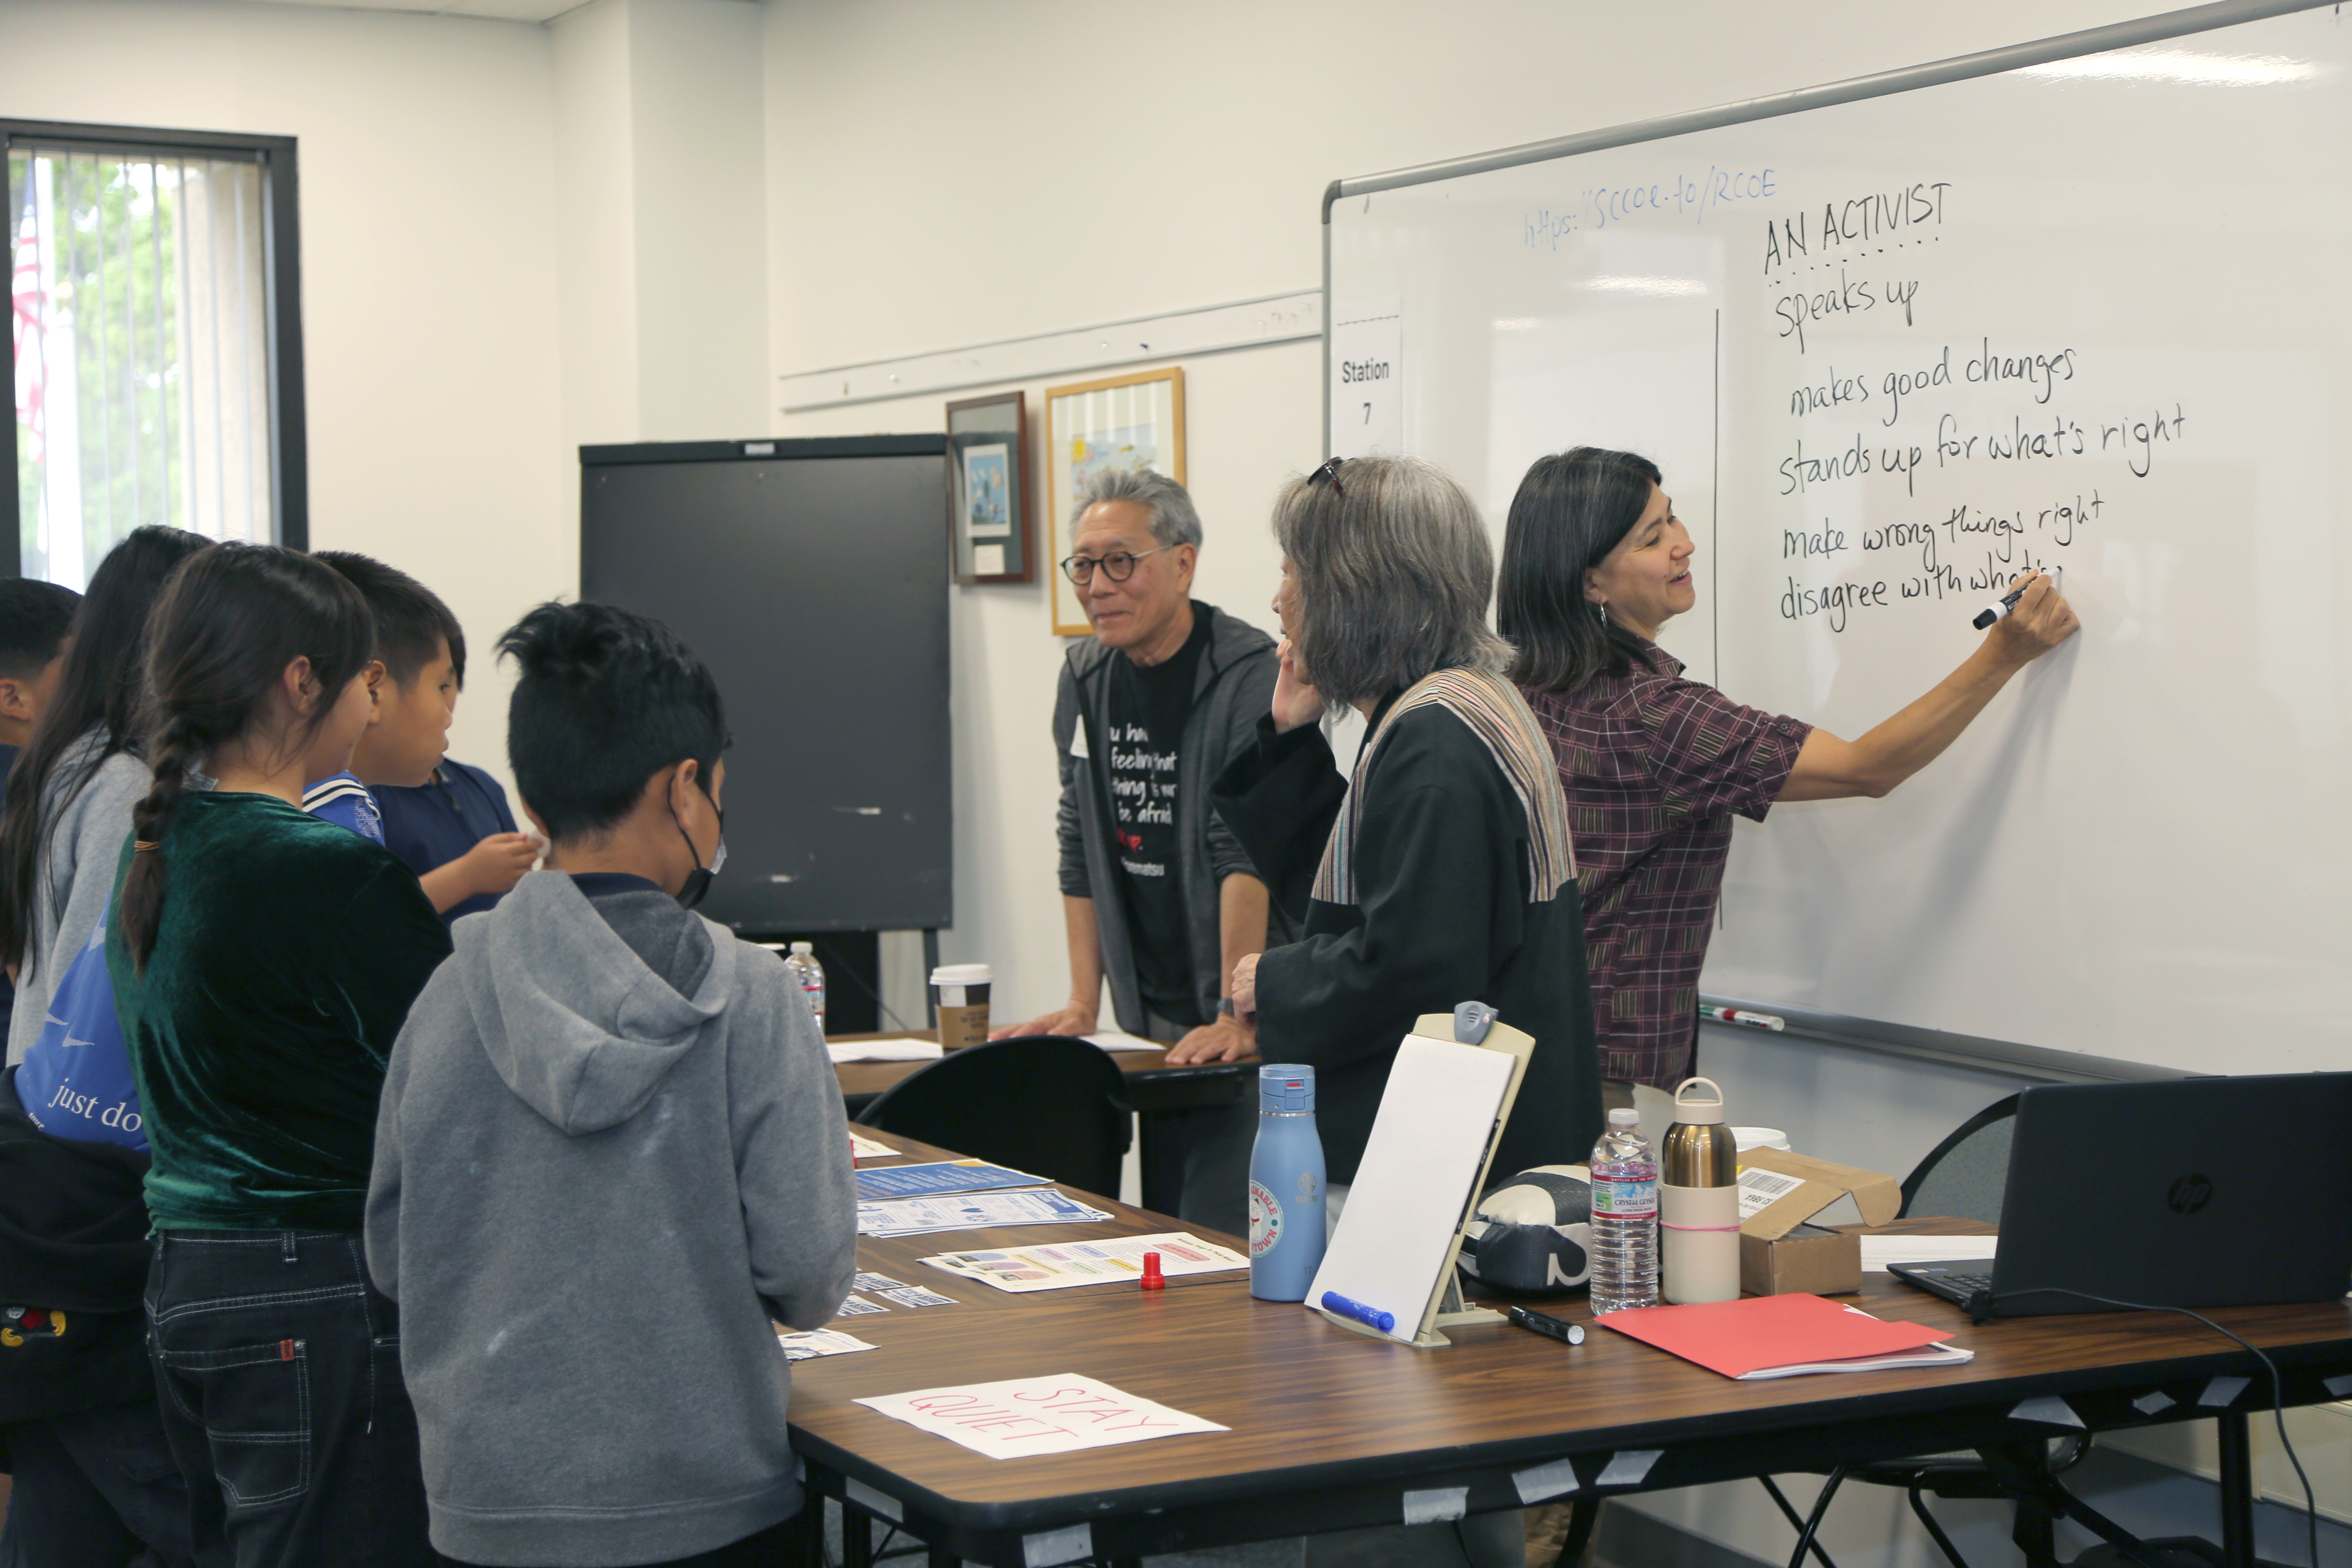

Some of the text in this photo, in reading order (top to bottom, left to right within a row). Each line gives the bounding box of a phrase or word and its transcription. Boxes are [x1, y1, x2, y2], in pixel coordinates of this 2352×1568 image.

[1765, 183, 1952, 275] AN ACTIVIST
[1776, 268, 1918, 354] speaks up
[1343, 357, 1389, 383] Station
[1791, 337, 2076, 426] makes good changes
[1363, 402, 1371, 424] 7
[1780, 403, 2186, 497] stands up for what's right
[1784, 489, 2105, 572] make wrong things right
[1781, 576, 1888, 633] disagree
[1902, 564, 1962, 599] with
[48, 1078, 143, 1132] just do
[909, 1395, 1079, 1440] QUIET
[1013, 1389, 1179, 1431] STAY
